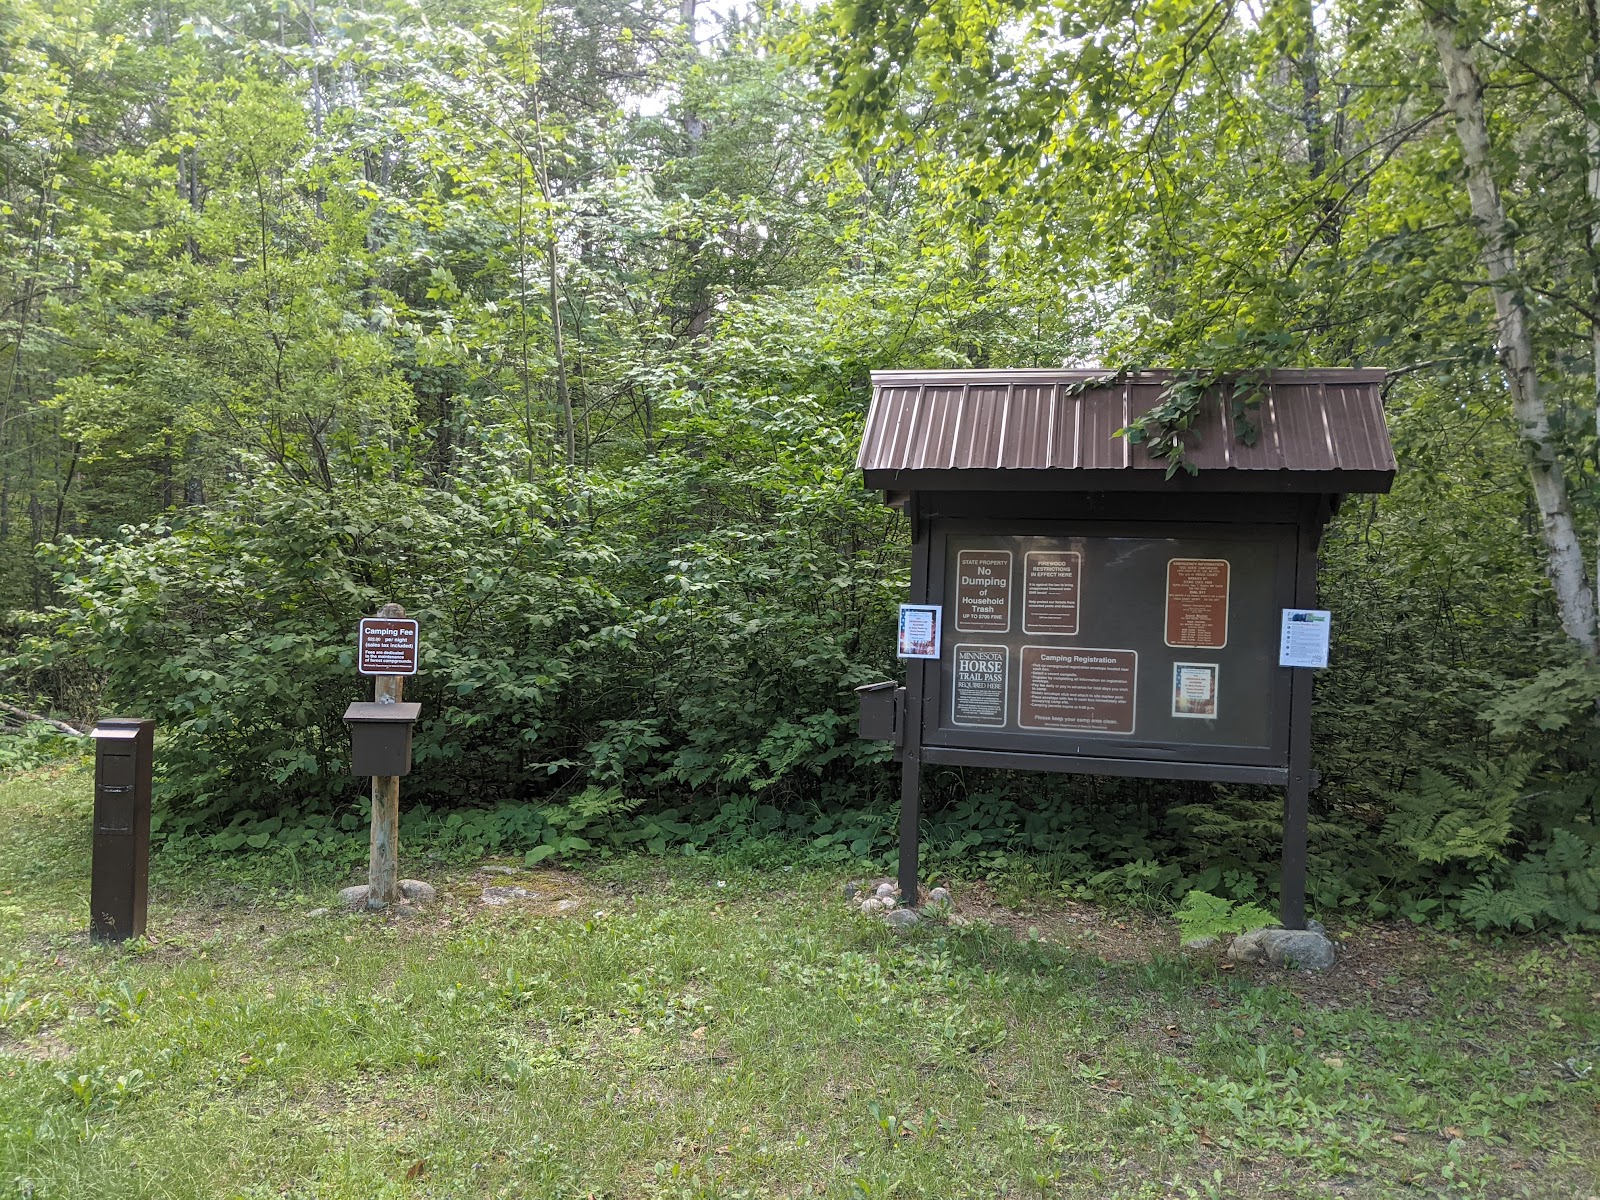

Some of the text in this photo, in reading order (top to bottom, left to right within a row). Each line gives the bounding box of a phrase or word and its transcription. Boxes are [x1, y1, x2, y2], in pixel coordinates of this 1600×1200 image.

[978, 567, 991, 575] No
[962, 576, 1006, 588] Dumping
[365, 628, 398, 636] Camping
[1041, 654, 1072, 662] Camping
[959, 660, 1002, 673] HORSE
